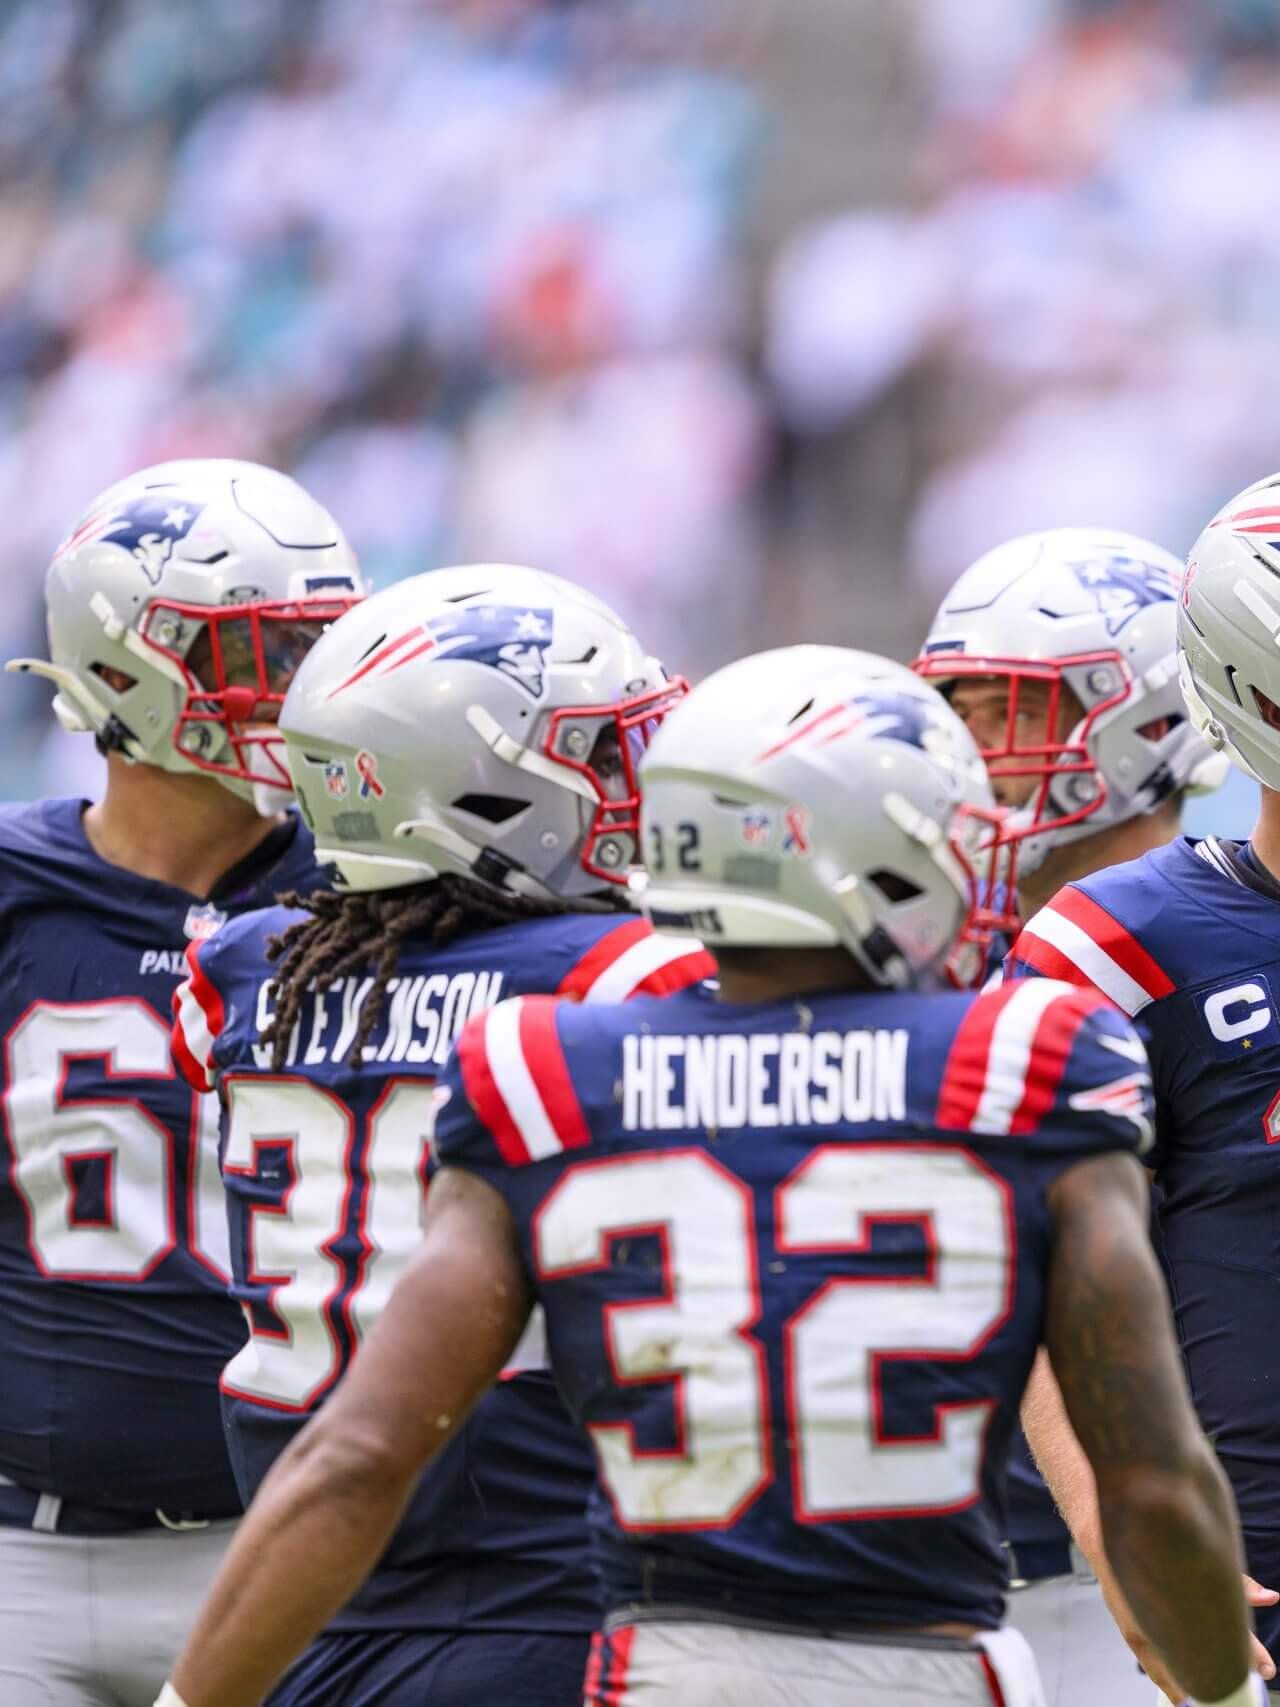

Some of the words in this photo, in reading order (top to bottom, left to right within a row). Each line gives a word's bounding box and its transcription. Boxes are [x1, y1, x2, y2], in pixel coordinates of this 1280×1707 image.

[1204, 983, 1271, 1042] C
[621, 1029, 909, 1131] HENDERSON
[532, 1141, 1018, 1533] 32
